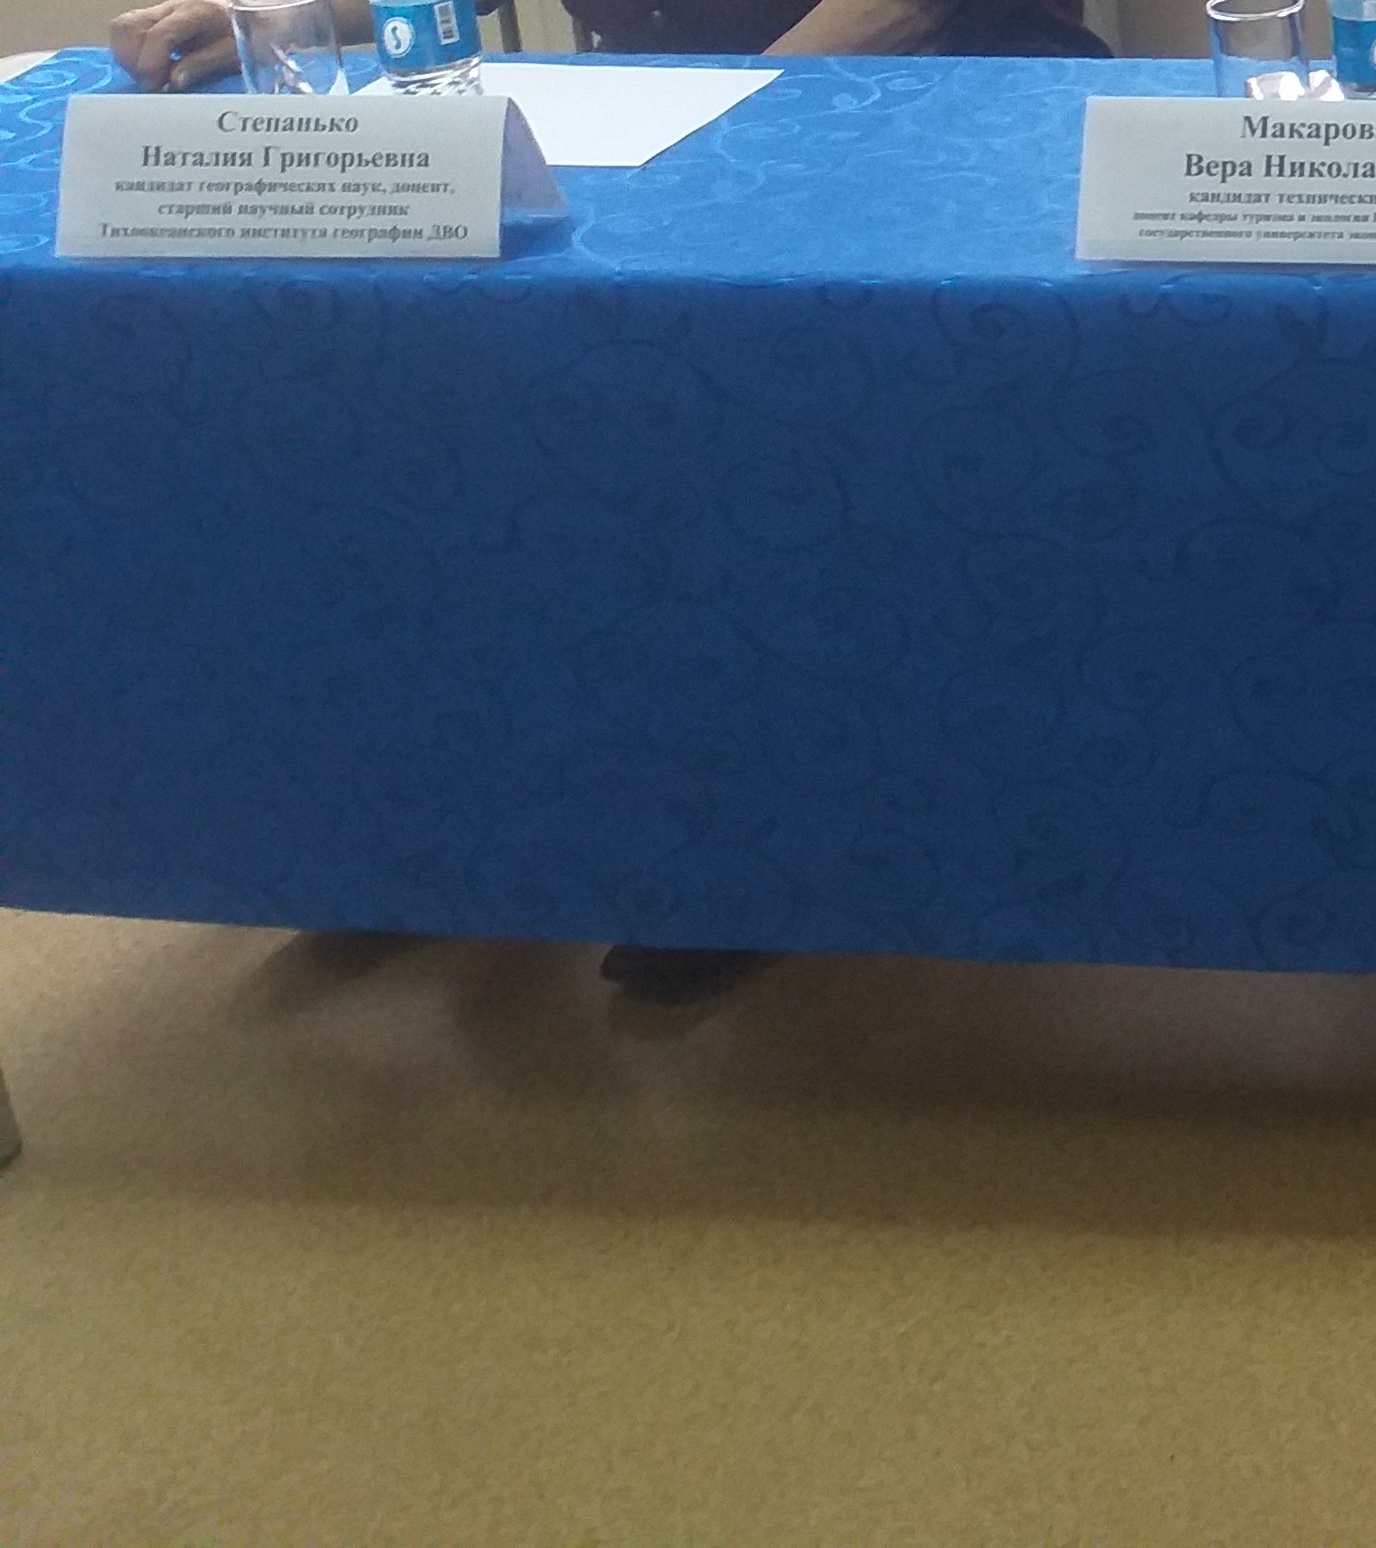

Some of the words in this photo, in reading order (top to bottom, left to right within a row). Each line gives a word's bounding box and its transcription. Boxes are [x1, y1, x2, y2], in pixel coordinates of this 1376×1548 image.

[216, 110, 359, 133] Степанько
[142, 144, 253, 168] Наталия
[262, 145, 430, 174] Григорьевна
[1184, 153, 1255, 183] Вера
[115, 180, 194, 193] кандидат
[199, 178, 336, 197] географических
[340, 182, 387, 197] наук,
[389, 181, 456, 195] доцент,
[1188, 191, 1271, 205] кандидат
[157, 202, 233, 220] старший
[237, 202, 315, 219] научный
[318, 203, 410, 220] сотрудник
[100, 222, 236, 238] Тихоокеанского
[240, 227, 327, 240] института
[333, 225, 424, 244] географии
[427, 224, 468, 240] ДВО
